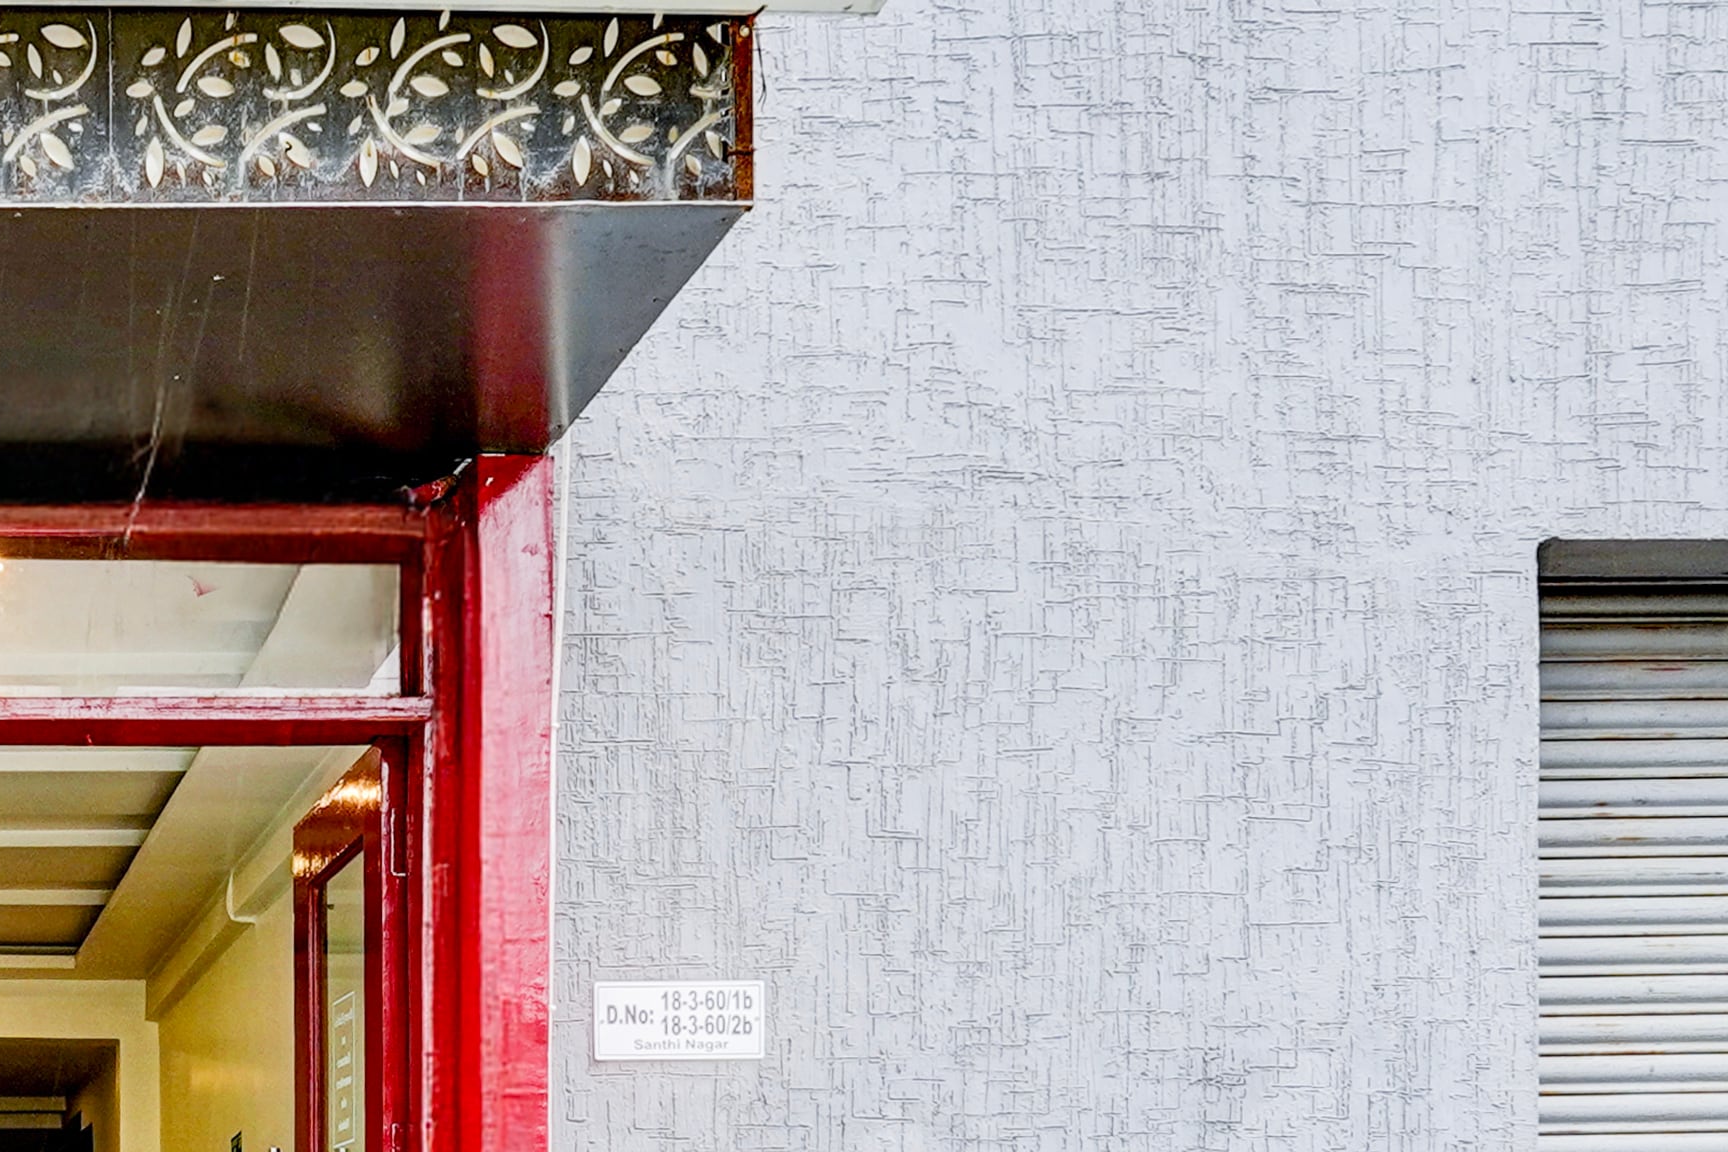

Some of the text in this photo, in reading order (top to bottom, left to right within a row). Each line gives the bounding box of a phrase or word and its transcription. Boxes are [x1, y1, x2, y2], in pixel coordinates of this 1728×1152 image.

[661, 990, 753, 1011] 18-3-60/1b
[606, 1004, 654, 1025] D.No:
[661, 1014, 753, 1035] 18-3-60/2b
[633, 1039, 729, 1053] Santhi Nagar
